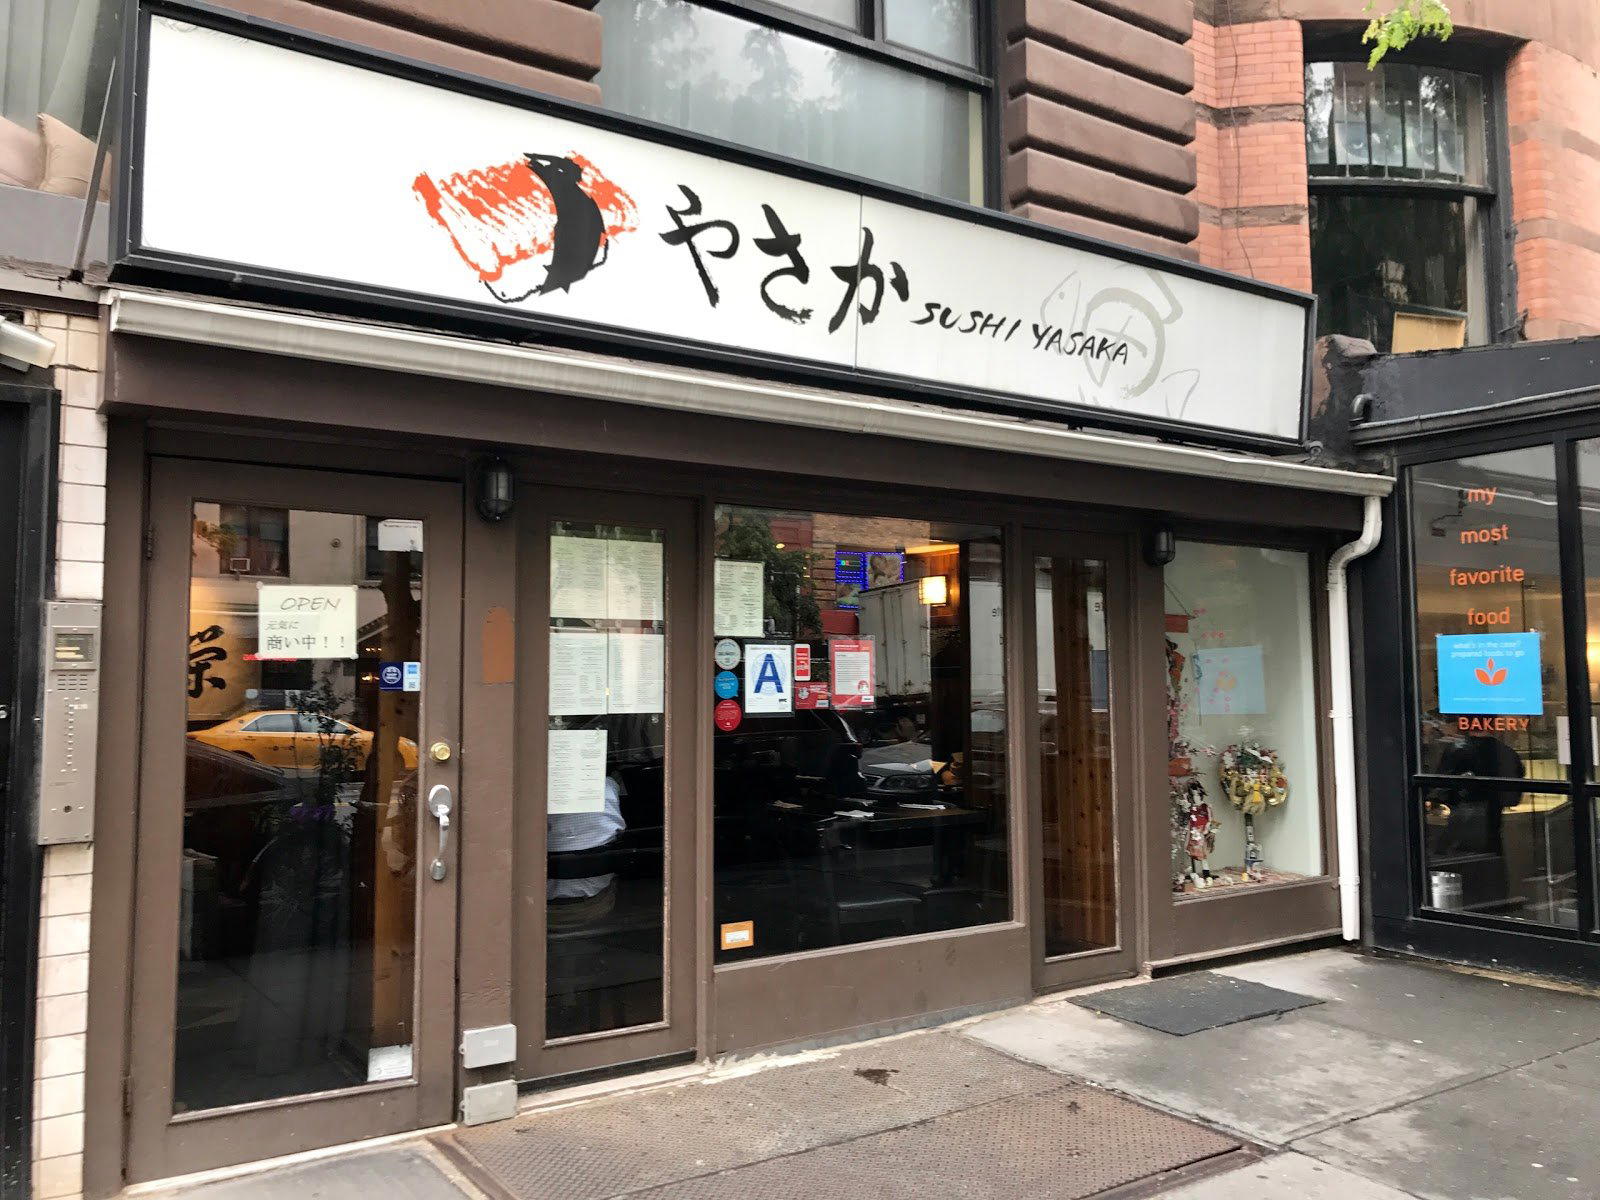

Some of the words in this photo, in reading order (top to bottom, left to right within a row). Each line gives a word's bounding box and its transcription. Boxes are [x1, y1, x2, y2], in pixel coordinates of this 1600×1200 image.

[659, 184, 910, 335] やさか
[911, 302, 1022, 342] SUSHI
[1031, 323, 1129, 365] YASAKA
[1467, 486, 1497, 506] my
[1460, 524, 1509, 545] most
[1449, 565, 1525, 587] favorite
[280, 597, 341, 611] OPEN
[1467, 607, 1511, 626] food
[753, 653, 784, 694] A
[1458, 716, 1530, 731] BAKERY
